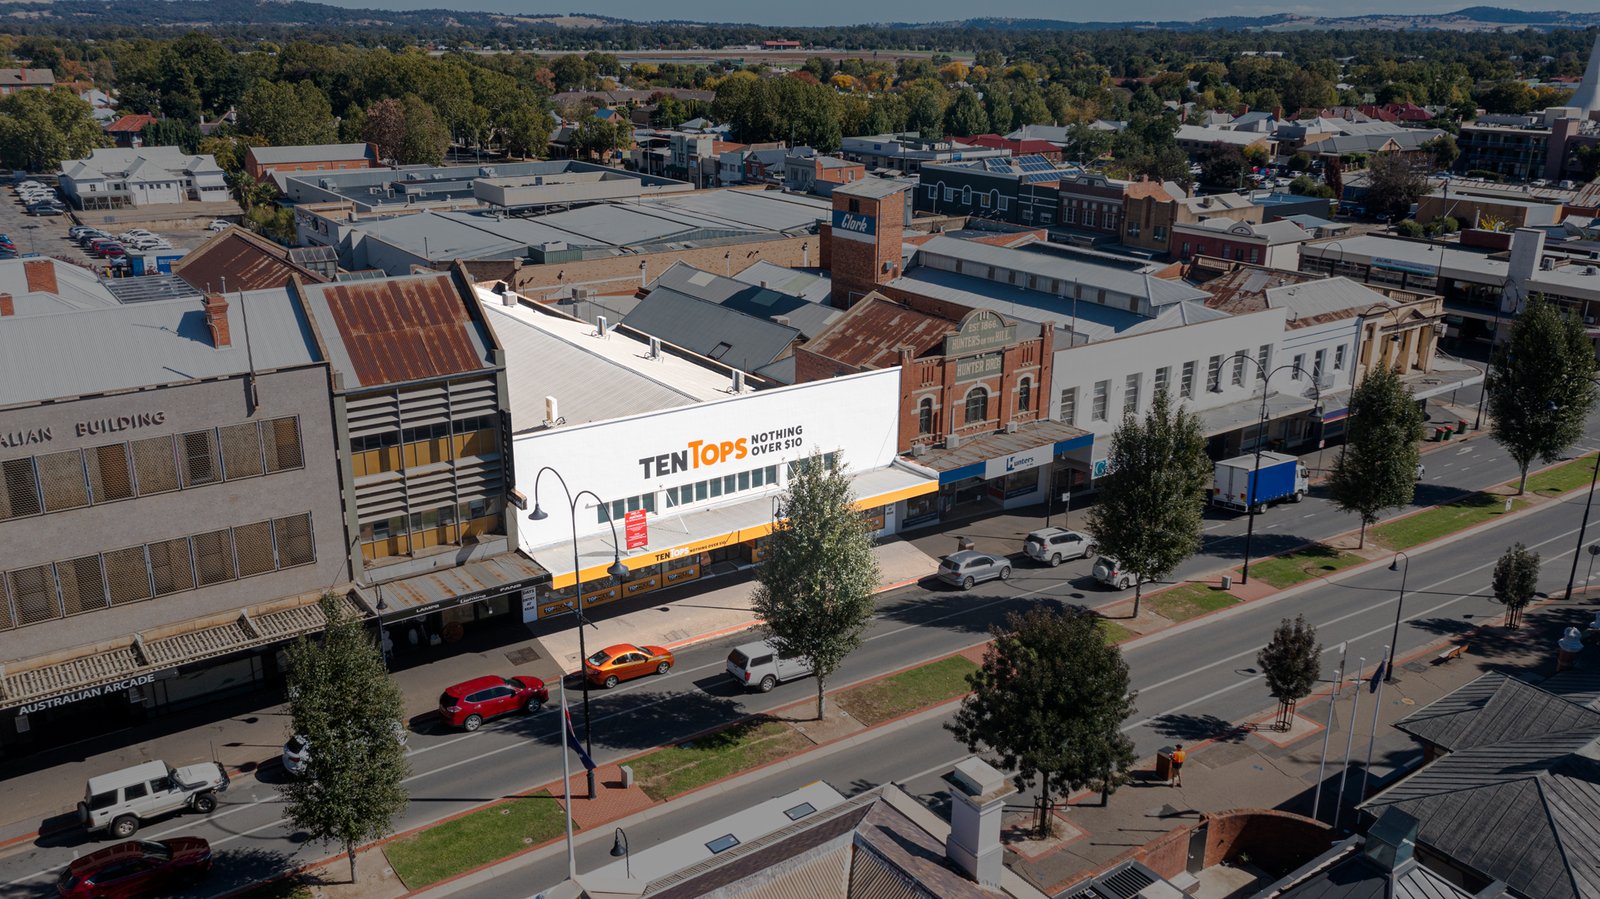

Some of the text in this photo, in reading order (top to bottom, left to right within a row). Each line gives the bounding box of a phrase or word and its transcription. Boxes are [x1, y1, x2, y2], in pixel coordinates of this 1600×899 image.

[841, 213, 868, 232] Clark
[951, 334, 981, 350] HUNTERS
[957, 360, 984, 377] HUNTER
[75, 411, 165, 438] BUILDING
[751, 425, 803, 445] NOTHING
[751, 437, 803, 456] OVER $10
[18, 674, 155, 716] AUSTRALIAN ARCADE
